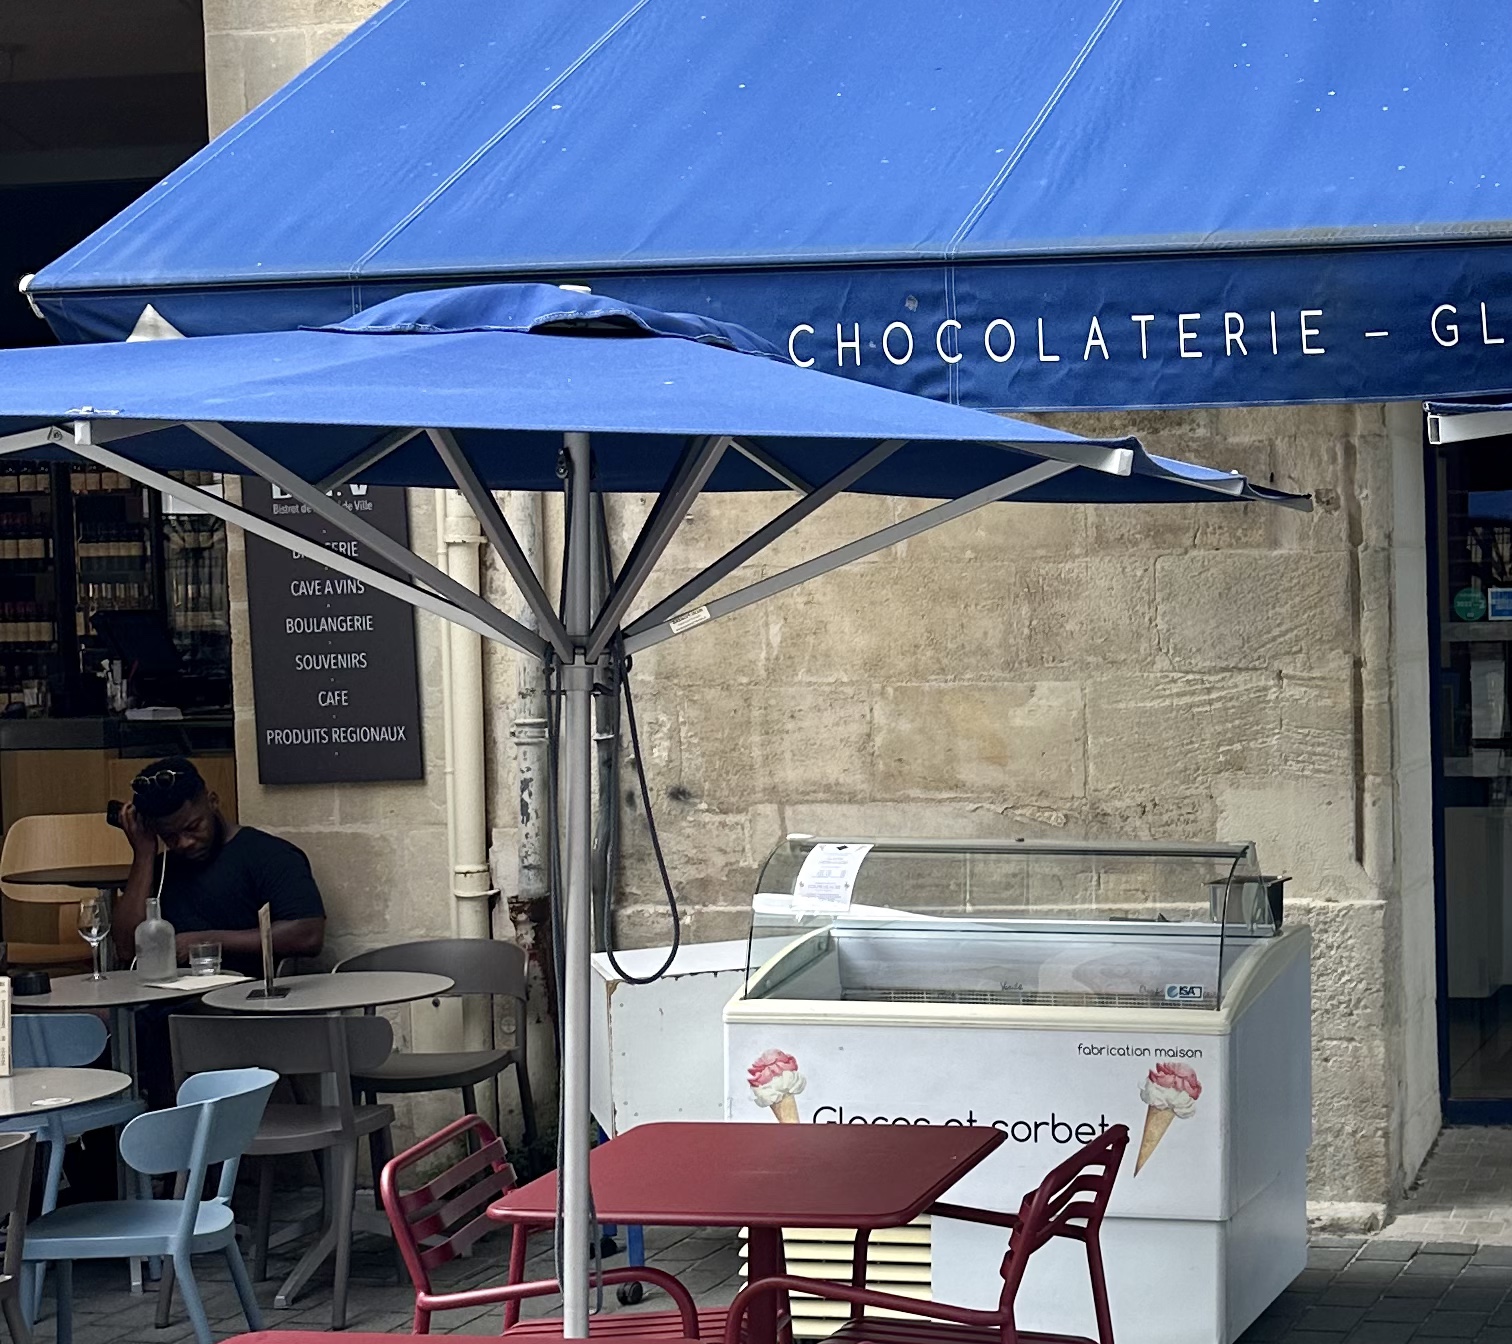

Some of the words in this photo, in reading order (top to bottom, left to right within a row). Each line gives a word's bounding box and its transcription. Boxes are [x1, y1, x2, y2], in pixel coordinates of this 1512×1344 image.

[787, 308, 1325, 368] CHOCOLATERIE
[290, 579, 323, 597] CAVE
[324, 579, 333, 596] A
[333, 578, 365, 596] VINS
[285, 615, 374, 634] BOULANGERIE
[295, 652, 368, 670] SOUVENIRS
[318, 689, 349, 707] CAFE
[266, 727, 329, 745] PRODUITS
[331, 725, 407, 744] REGIONAUX
[1077, 1043, 1151, 1057] fabrication
[1154, 1045, 1203, 1058] maison
